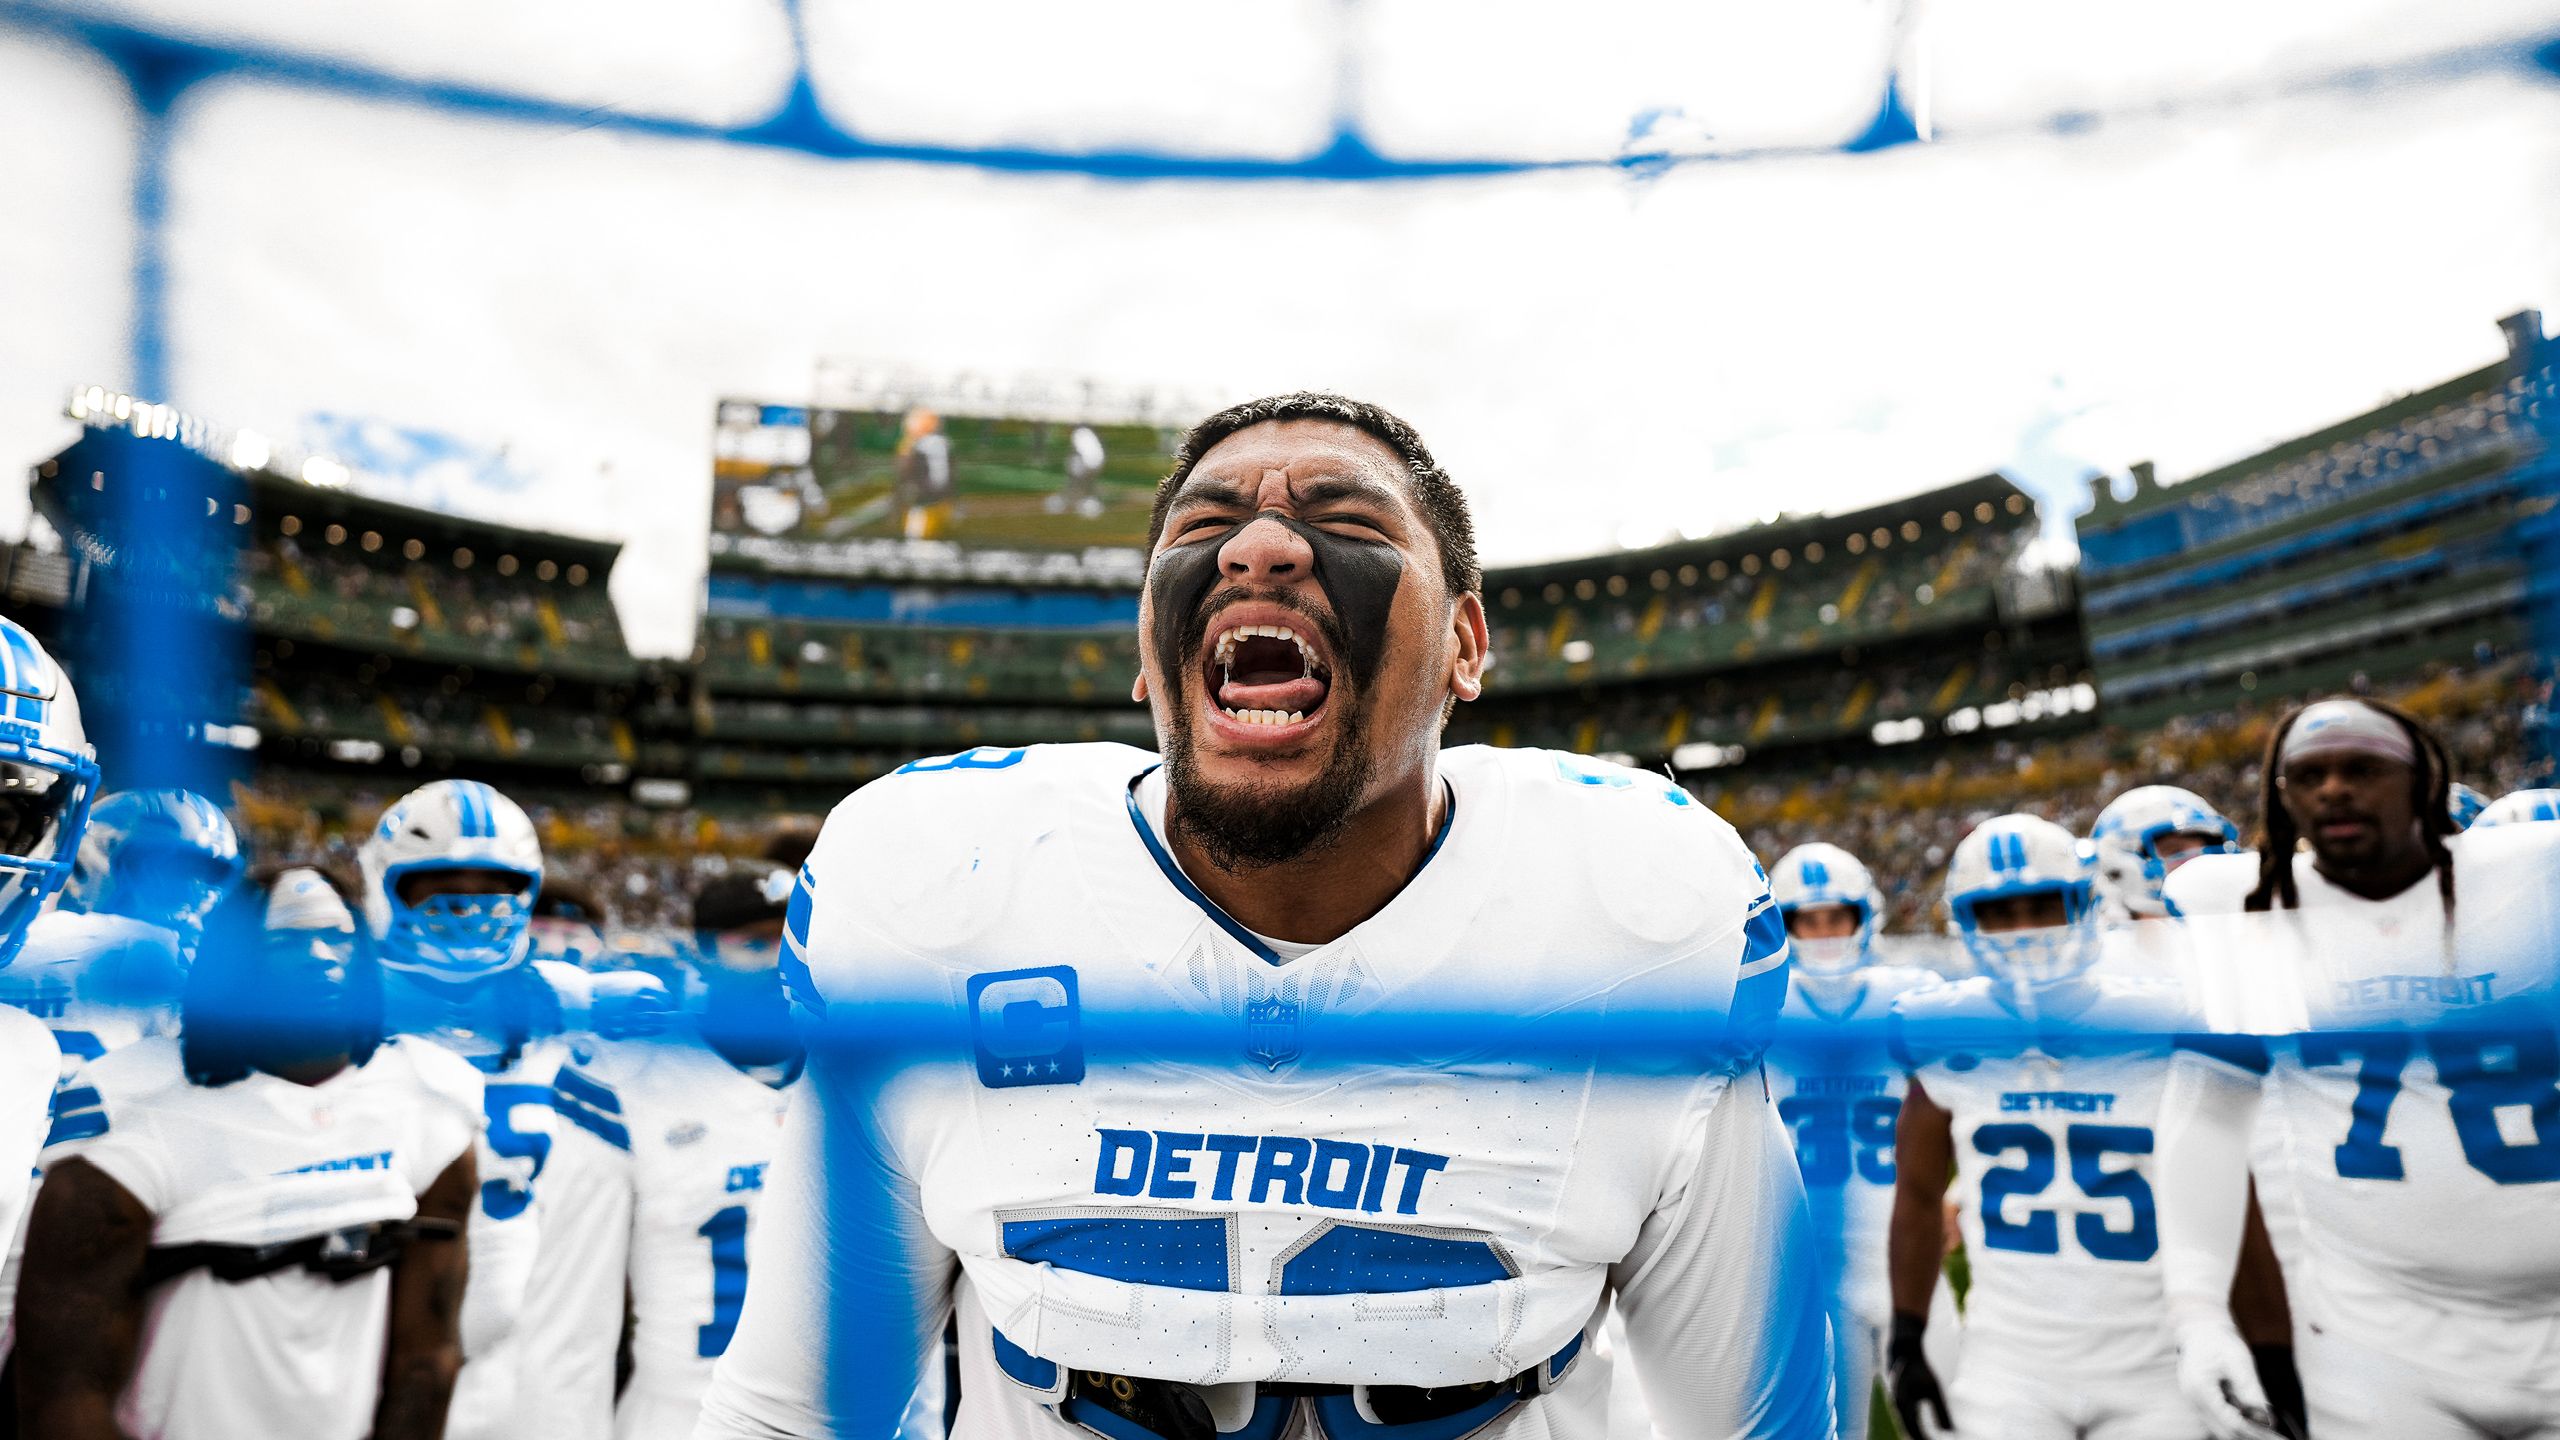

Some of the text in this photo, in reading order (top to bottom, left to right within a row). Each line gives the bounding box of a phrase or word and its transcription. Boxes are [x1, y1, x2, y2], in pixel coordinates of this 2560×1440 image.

[978, 976, 1069, 1059] C
[2299, 1030, 2560, 1185] 78
[1094, 1128, 1450, 1215] DETROIT
[1973, 1123, 2160, 1262] 25
